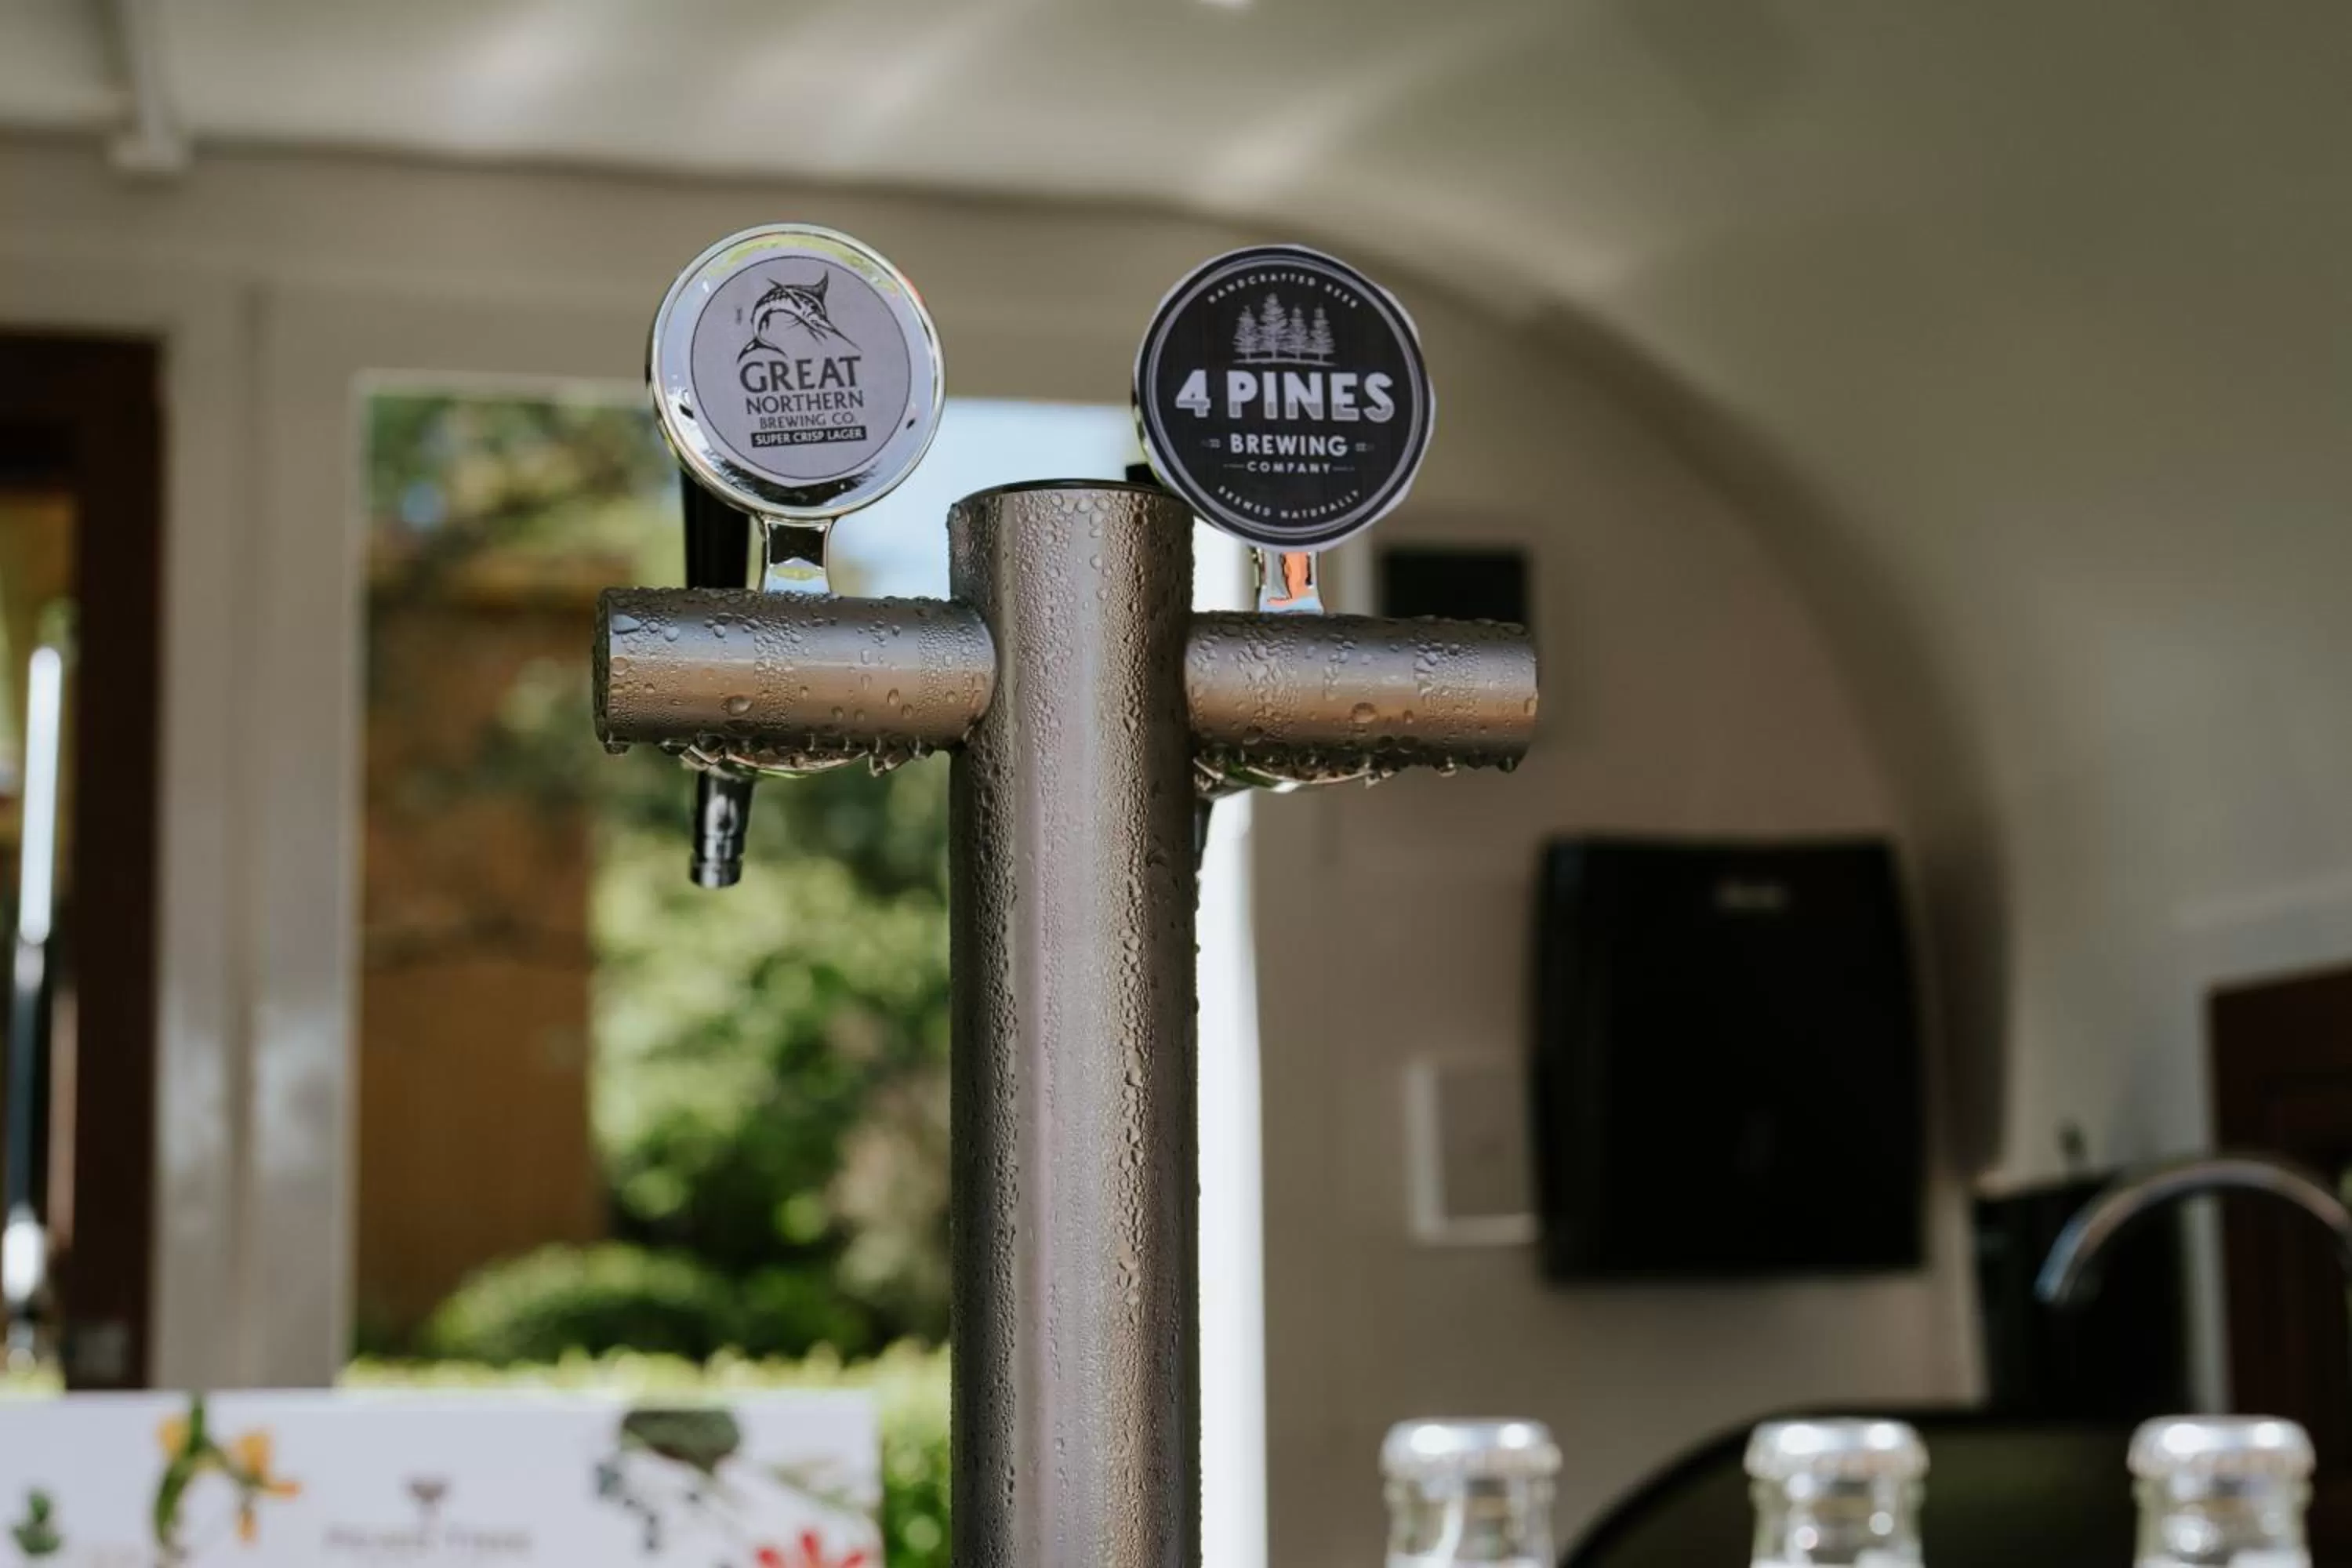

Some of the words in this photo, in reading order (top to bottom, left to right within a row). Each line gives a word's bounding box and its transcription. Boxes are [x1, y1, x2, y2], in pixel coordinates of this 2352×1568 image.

[1207, 273, 1316, 303] HANDCRAFTED
[1324, 283, 1358, 308] BEER
[739, 356, 862, 394] GREAT
[746, 390, 864, 415] NORTHERN
[1176, 369, 1211, 418] 4
[1227, 370, 1395, 423] PINES
[760, 413, 826, 430] BREWING
[755, 433, 790, 445] SUPER
[793, 430, 825, 443] CRISP
[827, 428, 863, 441] LAGER
[1229, 433, 1348, 456] BREWING
[1247, 461, 1330, 474] COMPANY
[1218, 485, 1272, 517] BREWED
[1280, 490, 1359, 519] NATURALLY
